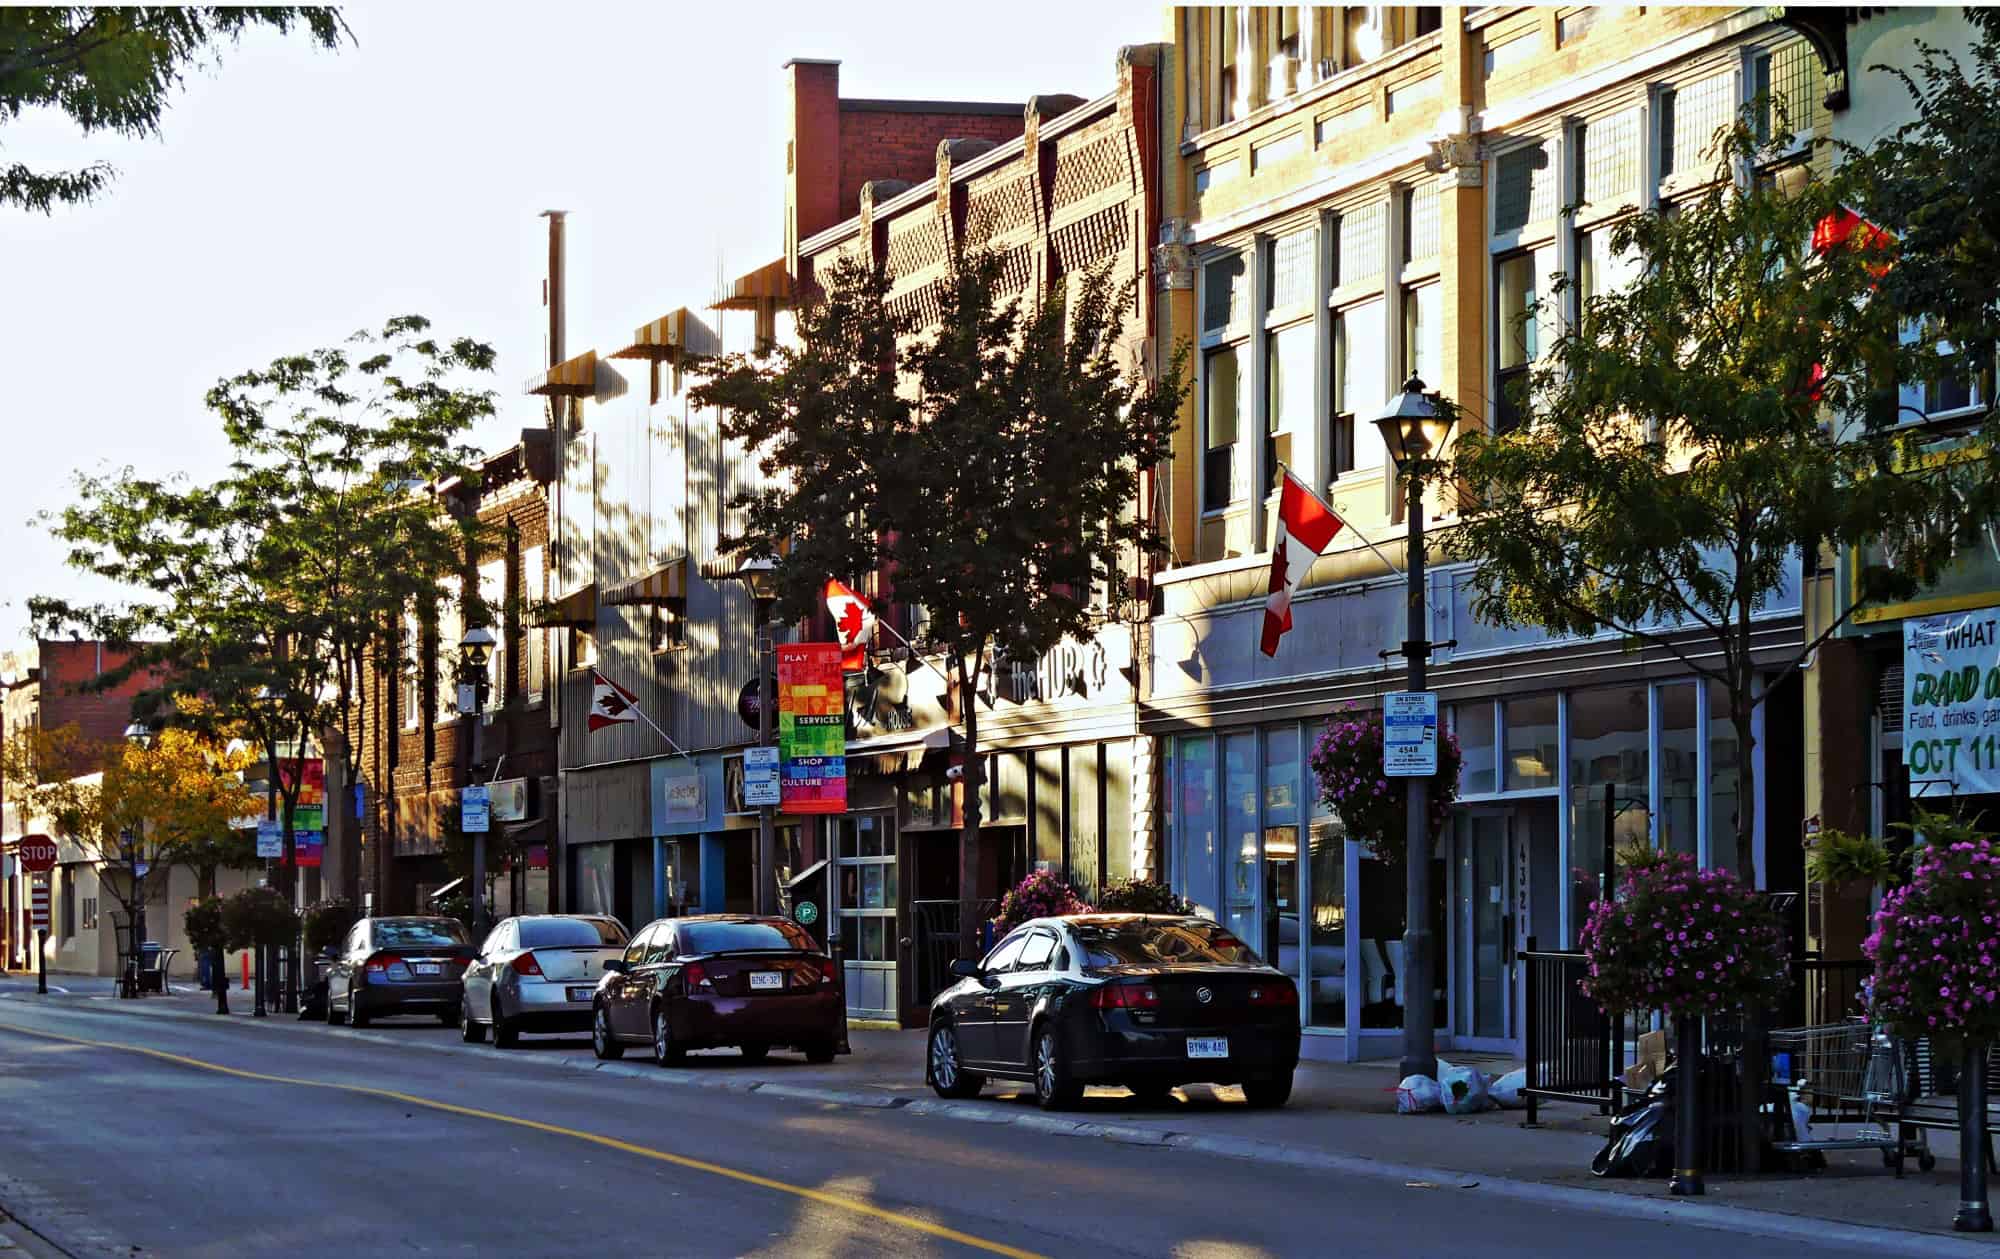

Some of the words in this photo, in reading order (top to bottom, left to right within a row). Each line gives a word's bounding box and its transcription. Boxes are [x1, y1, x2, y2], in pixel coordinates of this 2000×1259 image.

[1945, 620, 1996, 650] WHAT
[799, 717, 840, 725] SERVICES
[1911, 738, 1961, 776] OCT
[21, 846, 56, 860] STOP
